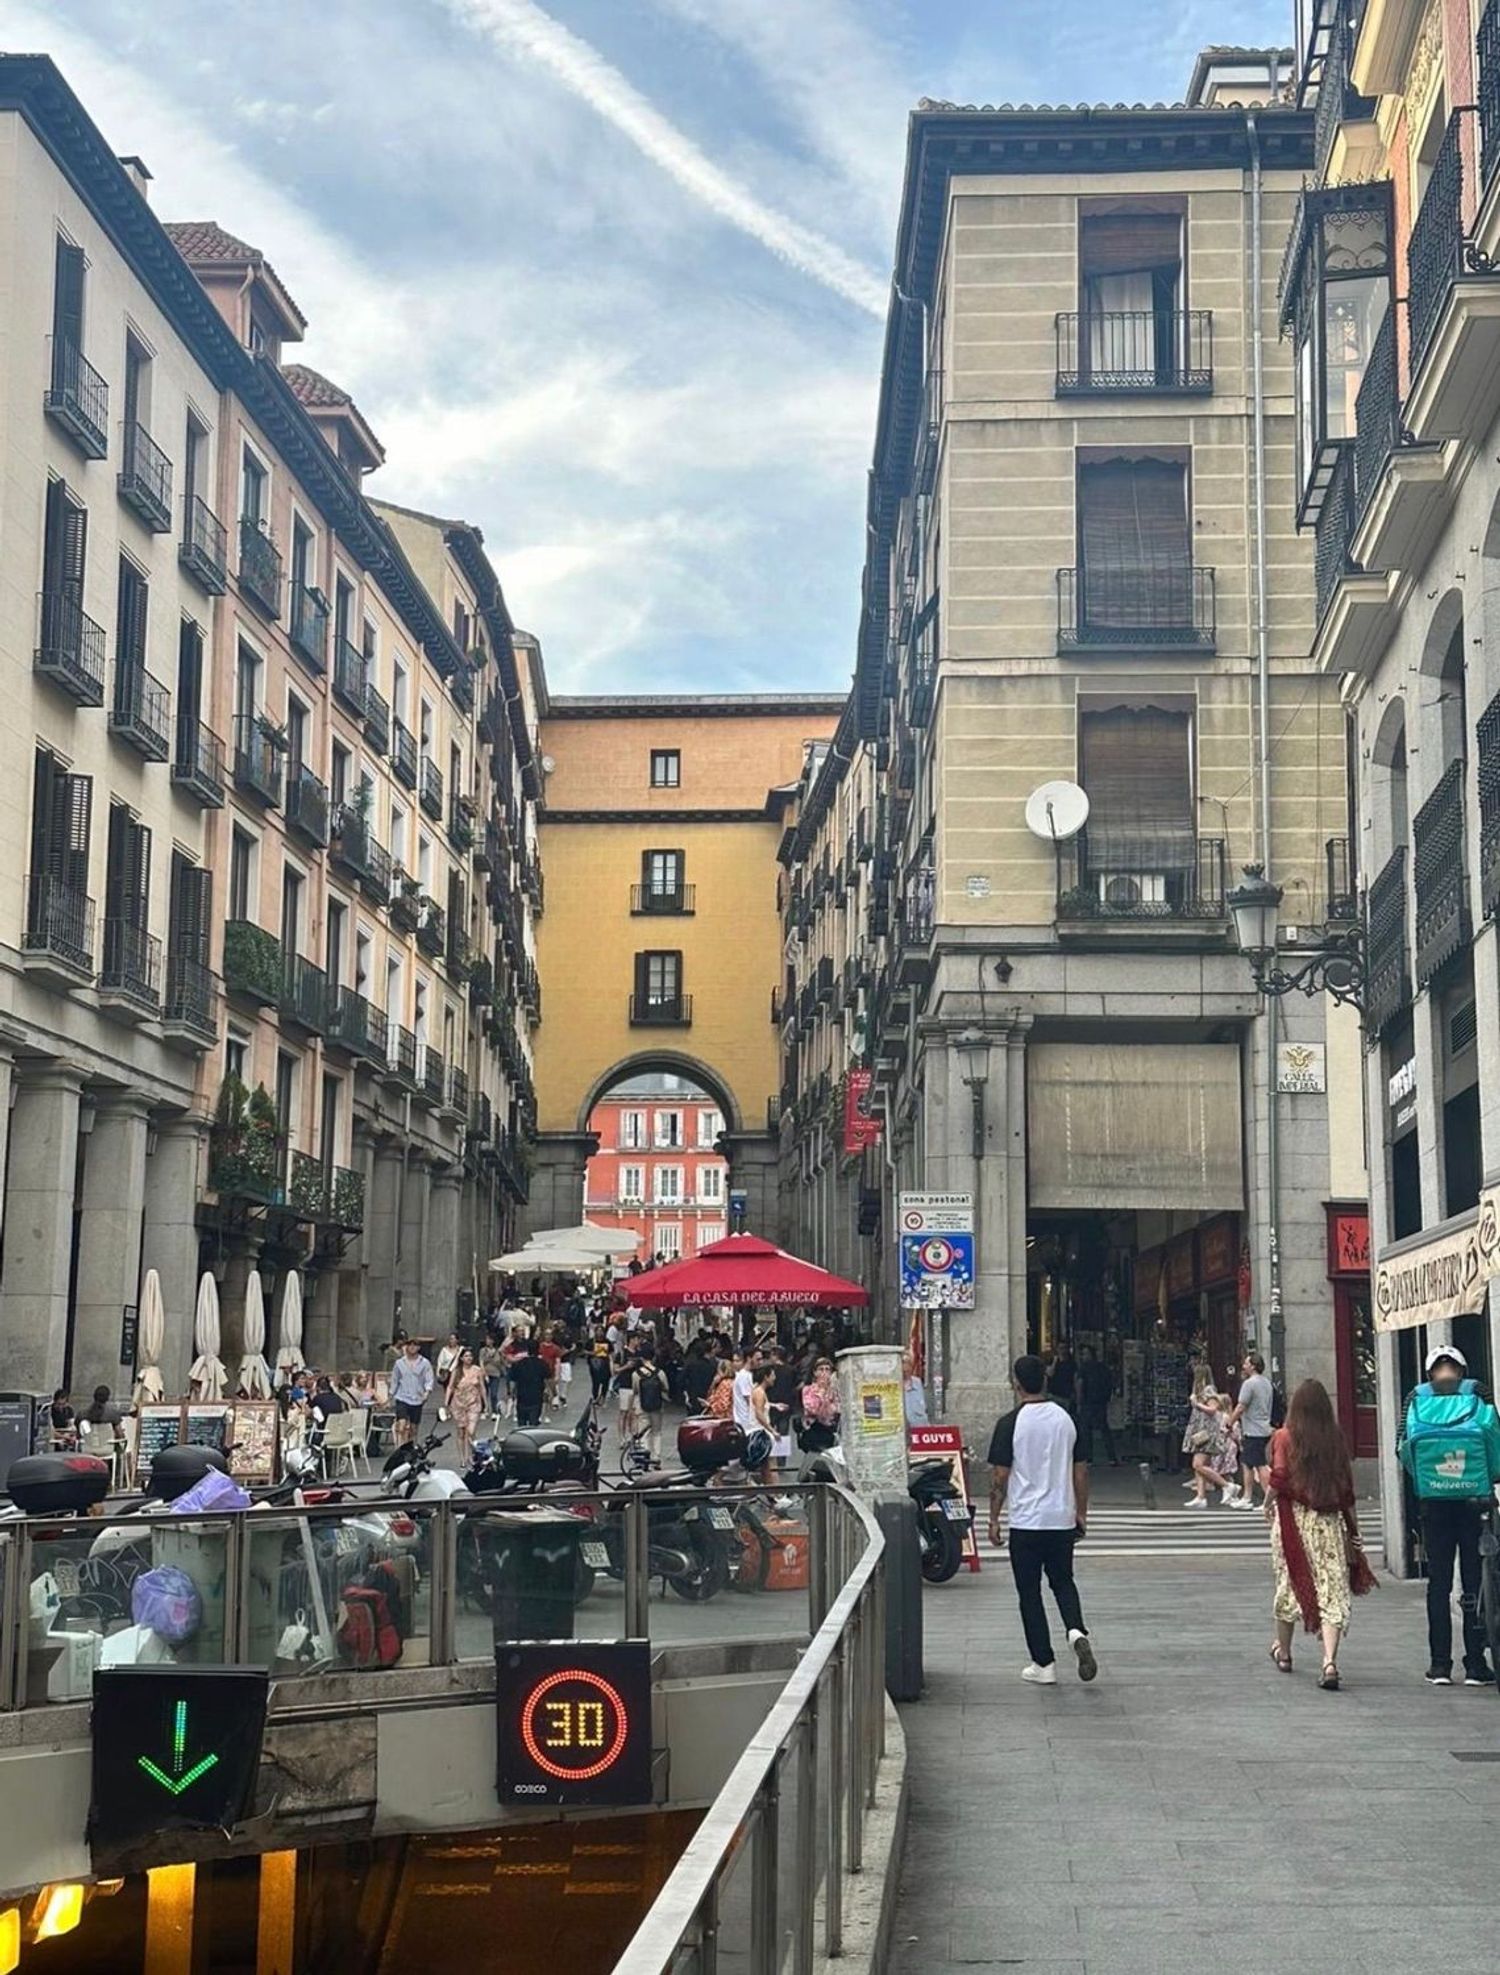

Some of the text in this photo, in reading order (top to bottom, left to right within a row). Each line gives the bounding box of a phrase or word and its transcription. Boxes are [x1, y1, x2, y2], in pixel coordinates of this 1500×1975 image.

[903, 1195, 925, 1204] zona
[683, 1291, 820, 1304] LA CASA DEL ABUELO
[922, 1433, 954, 1444] GUYS
[546, 1702, 604, 1748] 30
